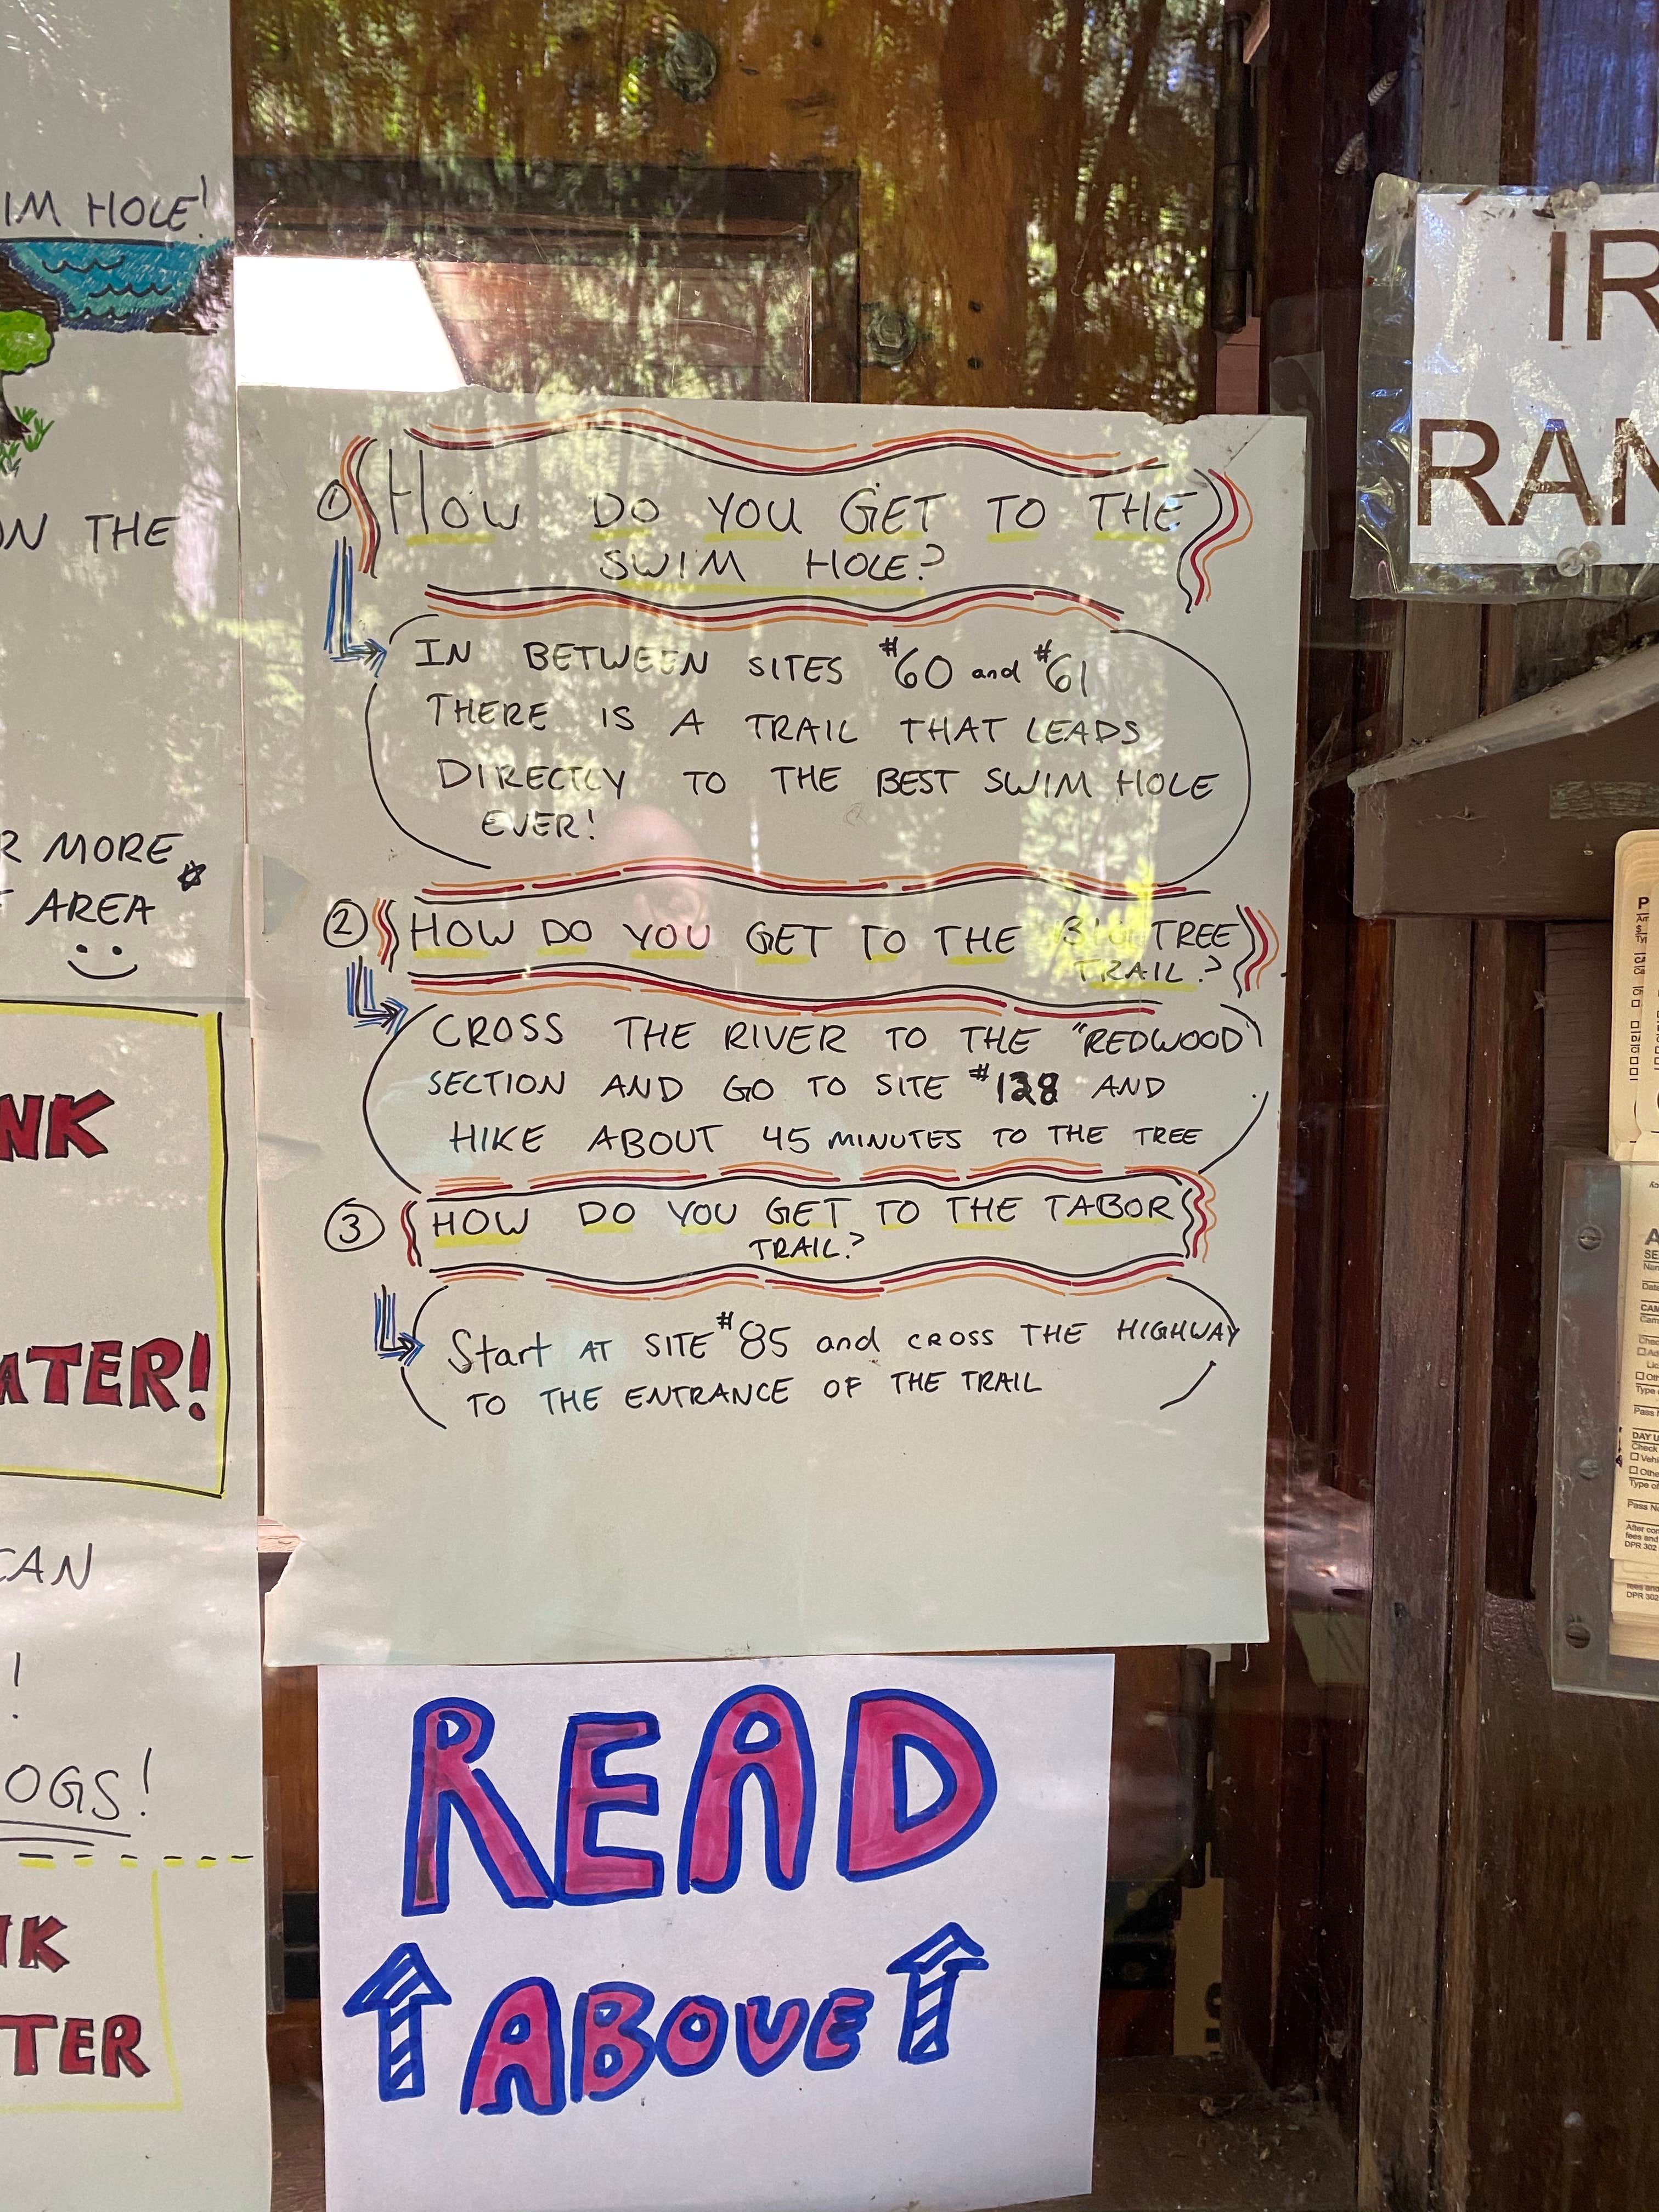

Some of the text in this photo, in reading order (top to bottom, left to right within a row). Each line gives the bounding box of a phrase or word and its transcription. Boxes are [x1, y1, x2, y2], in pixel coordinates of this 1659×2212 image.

[84, 174, 207, 242] HOLE!
[388, 444, 521, 535] HOW
[592, 492, 660, 529] DO
[707, 491, 803, 535] YOU
[839, 482, 947, 535] GET
[986, 494, 1046, 534] TO
[1088, 490, 1199, 533] THE
[0, 510, 177, 555] N THE
[599, 543, 945, 583] SWIM HOLE?
[414, 635, 1088, 698] IN BETWEEN SITES #60 and #61
[425, 692, 1141, 746] THERE IS A TRAIL THAT LEADS
[436, 758, 1221, 801] DIRECTLY TO THE BEST SWIM HOLE
[481, 808, 595, 841] EVER!
[42, 831, 184, 865] MORE
[24, 887, 156, 927] AREA
[409, 912, 515, 952] HOW
[540, 918, 593, 947] DO
[622, 923, 710, 952] YOU
[745, 920, 833, 958] GET
[860, 924, 906, 960] TO
[933, 925, 1023, 957] THE
[1150, 919, 1240, 951] TREE
[1074, 954, 1222, 983] TRAIL?
[432, 1012, 564, 1049] CROSS
[613, 1015, 697, 1052] THE
[724, 1021, 848, 1056] RIVER
[884, 1026, 928, 1052] TO
[959, 1025, 1042, 1056] THE
[427, 1069, 566, 1097] SECTION
[599, 1073, 684, 1103] AND
[723, 1074, 775, 1103] GO
[806, 1075, 847, 1098] TO
[875, 1073, 951, 1101] SITE
[1090, 1074, 1166, 1099] AND
[448, 1120, 1204, 1159] HIKE ABOUT 45 MINUTES TO THE TREE
[431, 1207, 529, 1238] HOW
[577, 1200, 636, 1227] DO
[667, 1200, 738, 1228] YOU
[765, 1195, 853, 1229] GET
[875, 1199, 920, 1226] TO
[945, 1195, 1023, 1224] THE
[1043, 1193, 1175, 1222] TABOR
[748, 1231, 866, 1261] TRAIL?
[447, 1310, 1241, 1375] Start AT SITE #85 and CROSS THE HIGHWAY
[466, 1370, 1043, 1418] TO THE ENTRANCE OF THE TRAIL
[1632, 1443, 1657, 1452] Check
[1633, 1432, 1651, 1441] DAY
[1624, 1541, 1657, 1551] DPR 302
[1626, 1523, 1644, 1532] After
[1626, 1532, 1642, 1540] fees
[1627, 1591, 1644, 1600] DPR
[2, 1747, 153, 1824] OGS!
[402, 1684, 997, 1916] READ
[460, 1976, 874, 2115] ABOVE
